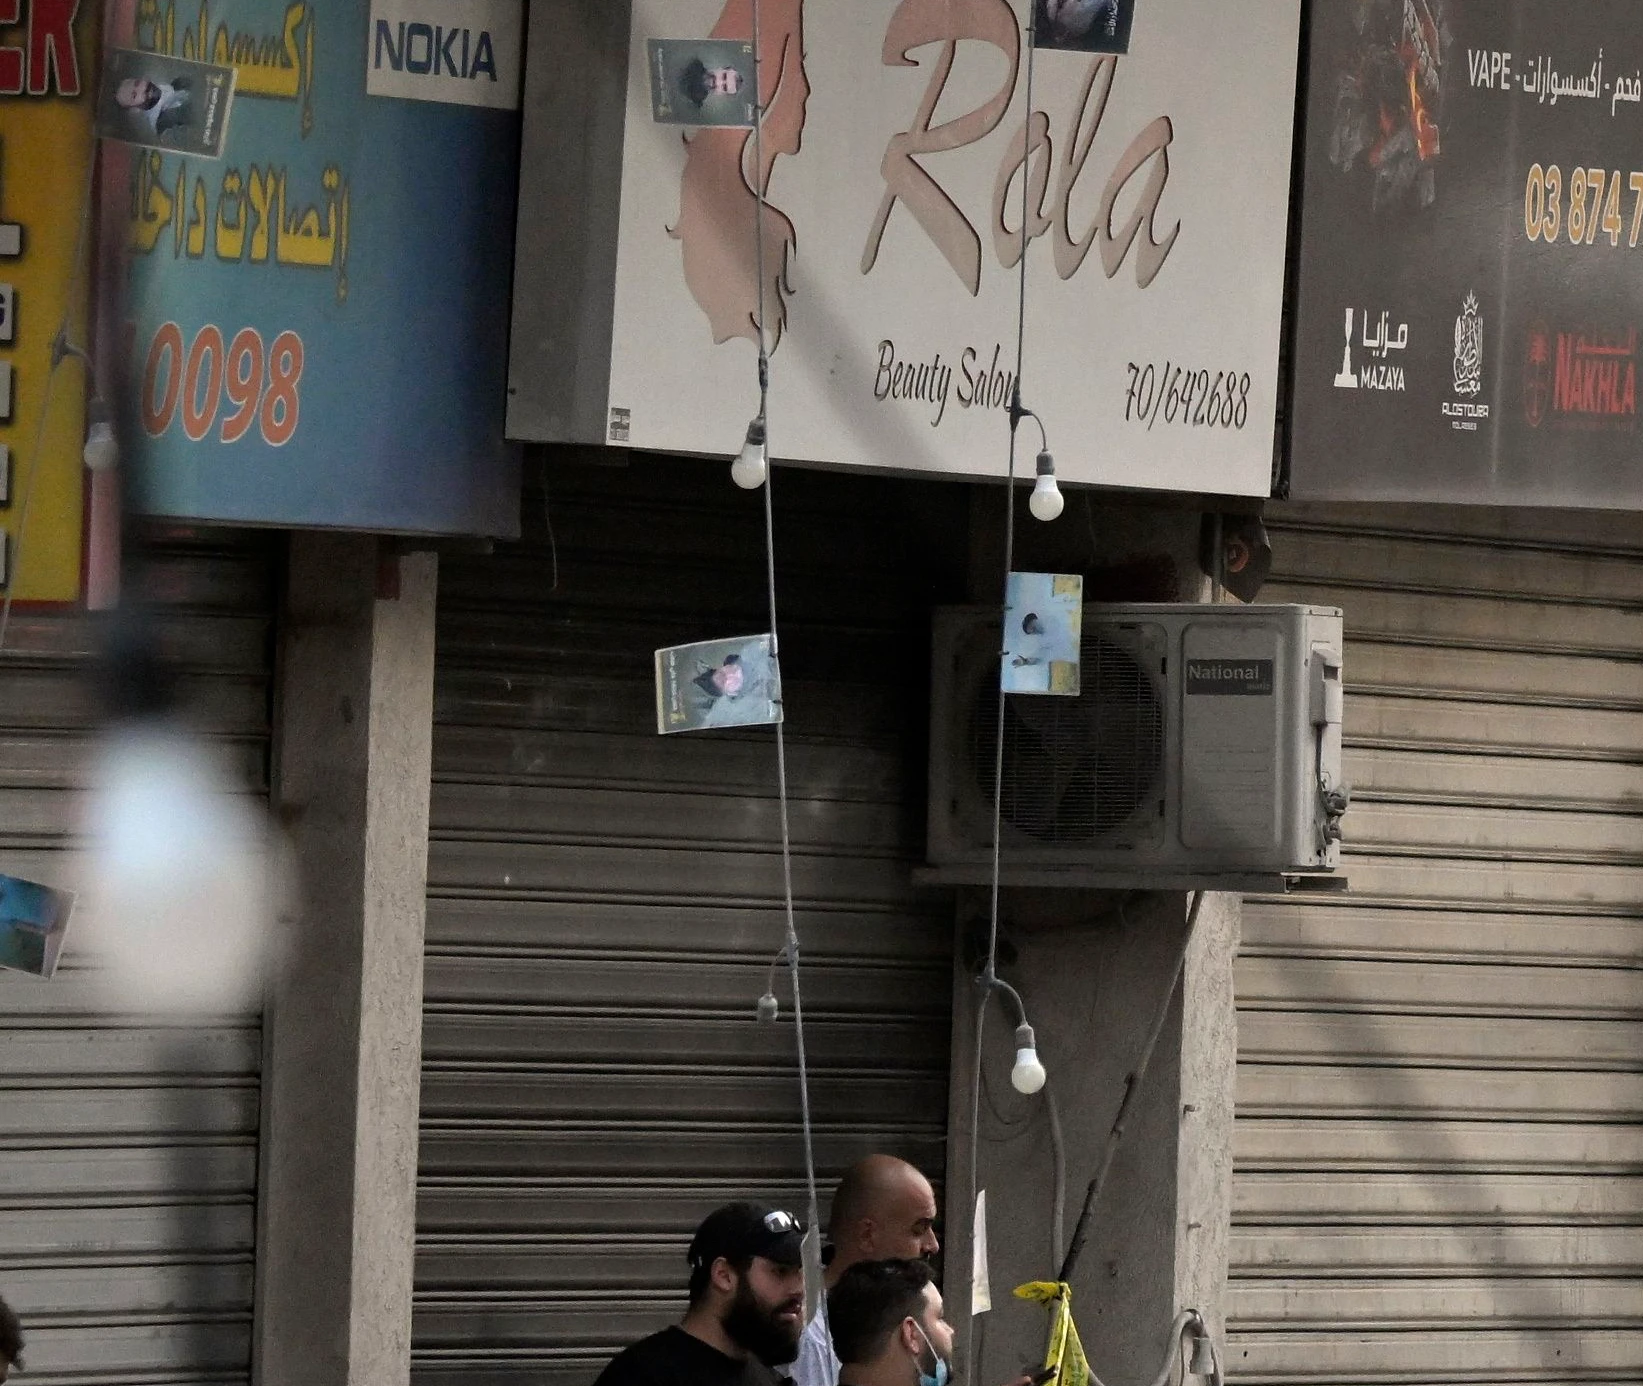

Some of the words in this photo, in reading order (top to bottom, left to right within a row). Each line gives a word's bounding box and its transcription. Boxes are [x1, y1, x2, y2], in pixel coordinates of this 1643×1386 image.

[374, 19, 498, 82] NOKIA
[1468, 49, 1512, 90] VAPE
[1523, 48, 1603, 105] أكسسوارات
[1612, 70, 1641, 116] فحم
[860, 0, 1181, 297] Rola
[1525, 163, 1562, 243] 03
[1568, 166, 1622, 247] 874
[1362, 308, 1408, 358] مزايا
[874, 339, 952, 427] Beauty
[1125, 360, 1252, 432] 70/642688
[1361, 365, 1406, 392] MAZAYA
[1188, 664, 1259, 679] National
